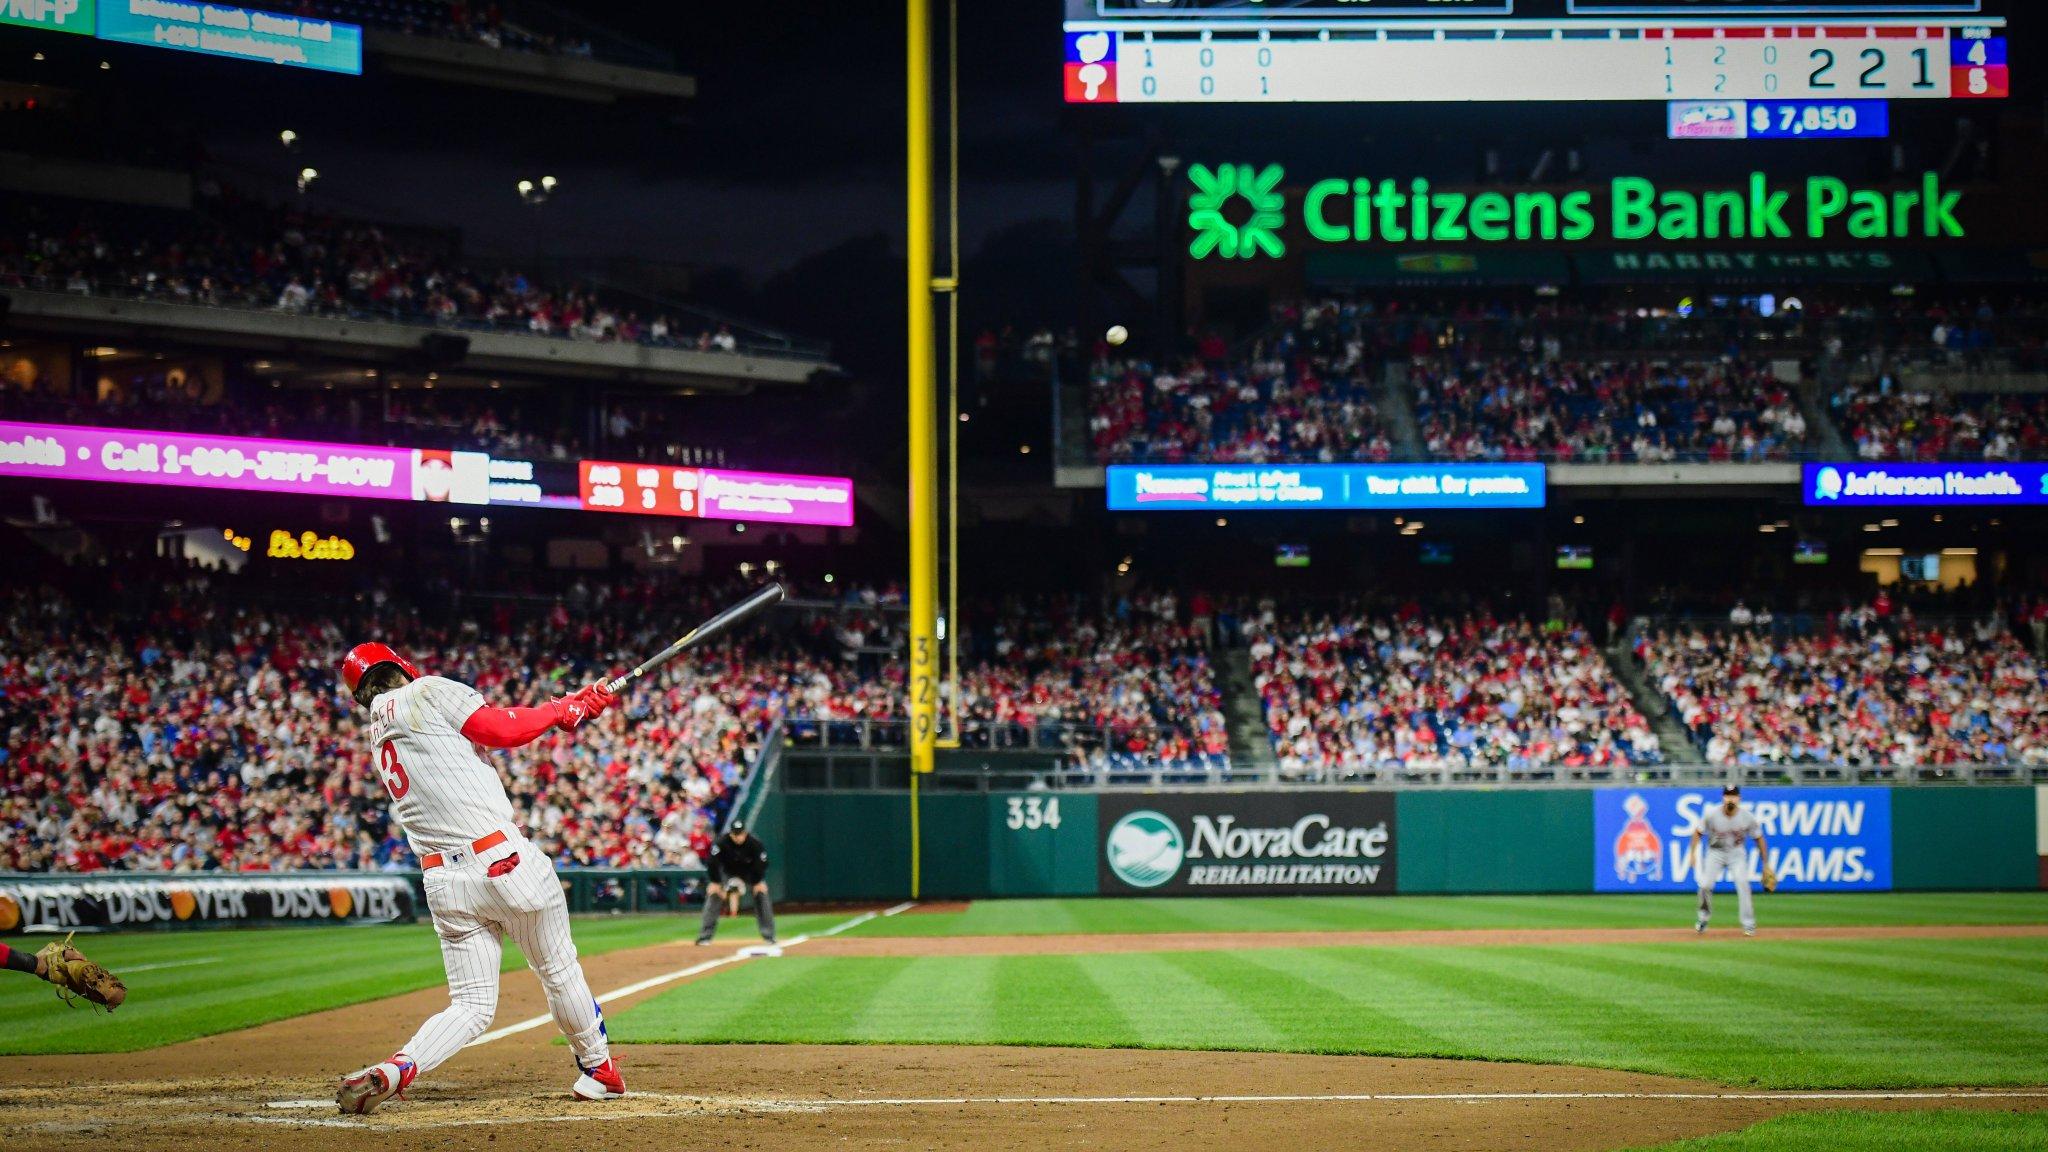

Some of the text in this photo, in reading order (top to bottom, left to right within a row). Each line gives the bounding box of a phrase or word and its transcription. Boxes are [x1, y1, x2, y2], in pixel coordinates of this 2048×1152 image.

[1144, 46, 1777, 67] 1 0 0 1 2 0
[1967, 39, 1987, 66] 4
[1808, 48, 1934, 88] 2 2 1
[1142, 74, 1777, 95] 0 0 1 1 2 0
[1304, 171, 1964, 242] Citizens Bank Park
[1613, 252, 1757, 270] HARRY
[101, 441, 159, 473] Call
[1006, 797, 1061, 830] 334
[1187, 863, 1381, 886] REHABILITATION
